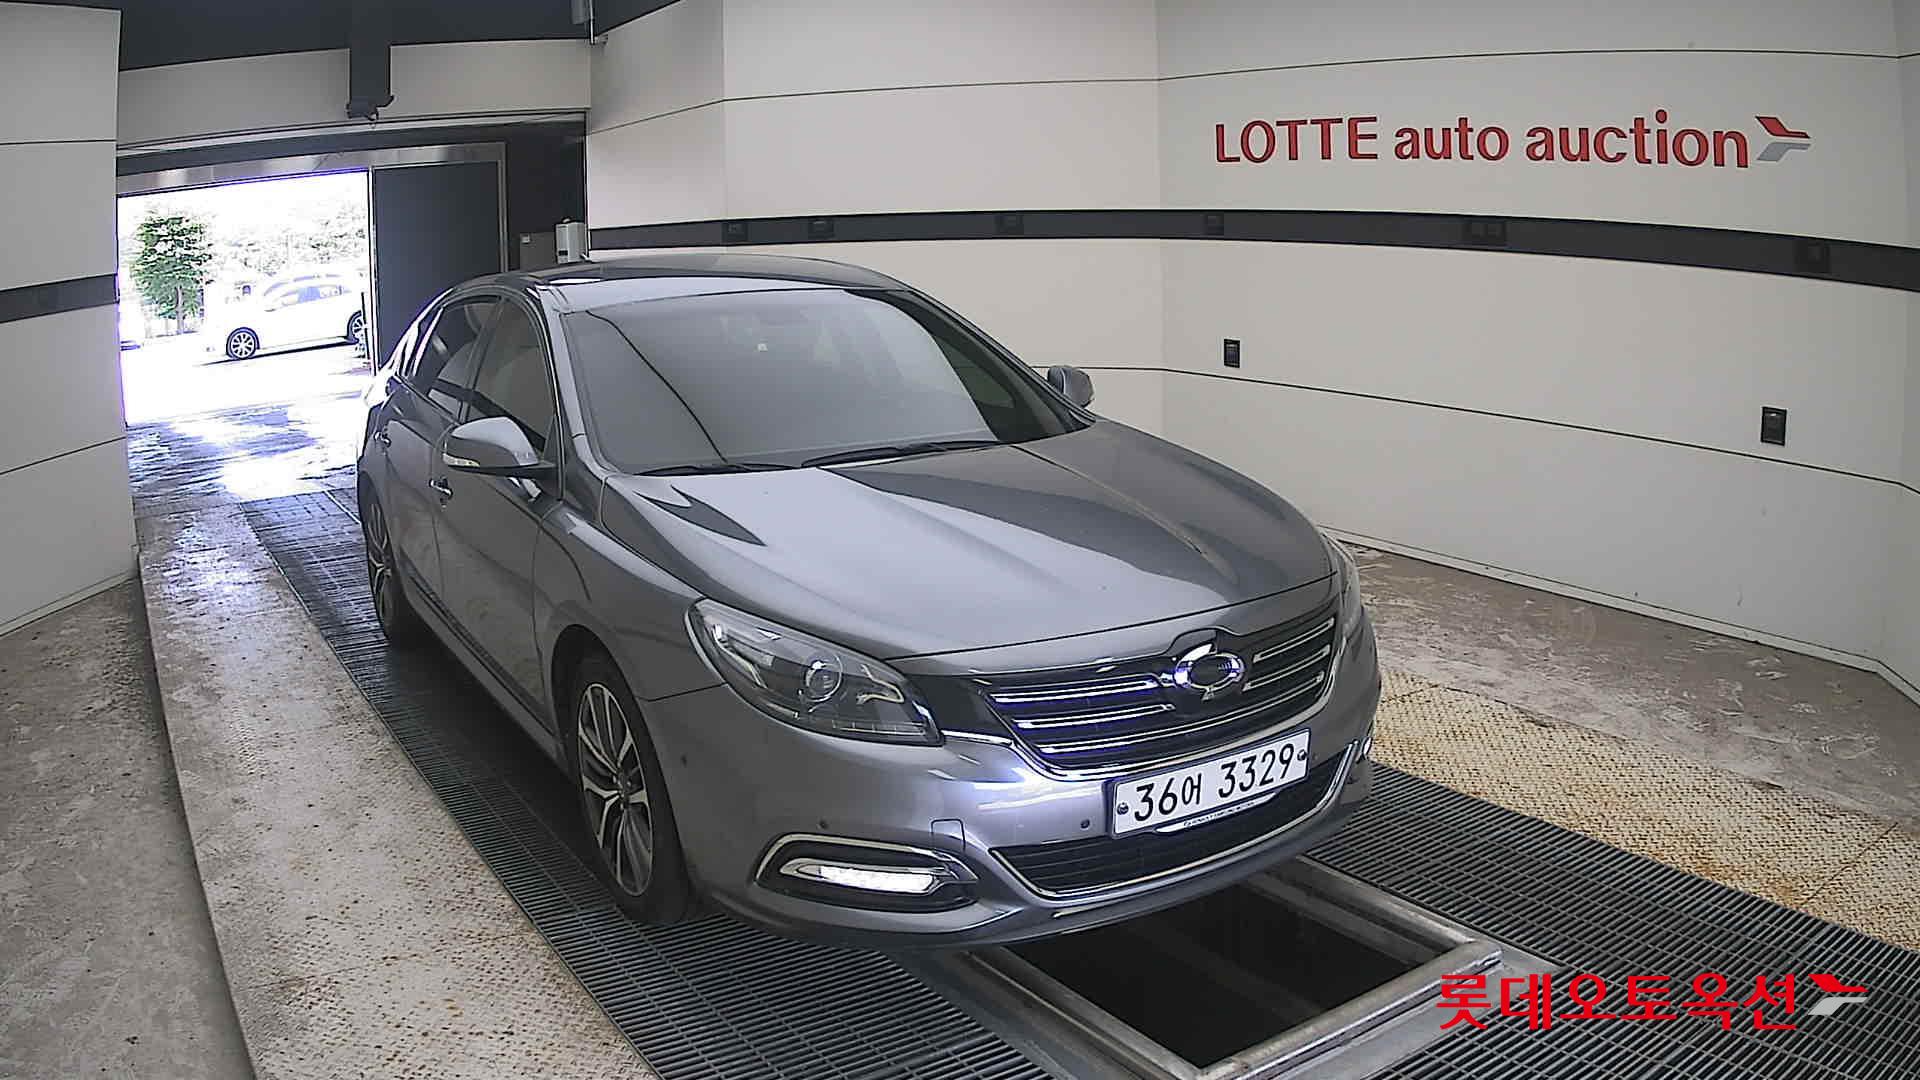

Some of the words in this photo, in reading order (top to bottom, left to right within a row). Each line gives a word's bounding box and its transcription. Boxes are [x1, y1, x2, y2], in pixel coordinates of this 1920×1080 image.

[1215, 116, 1378, 163] LOTTE
[1393, 116, 1509, 162] auto
[1525, 109, 1749, 168] auction
[1134, 772, 1202, 822] 36어
[1218, 743, 1295, 798] 3329
